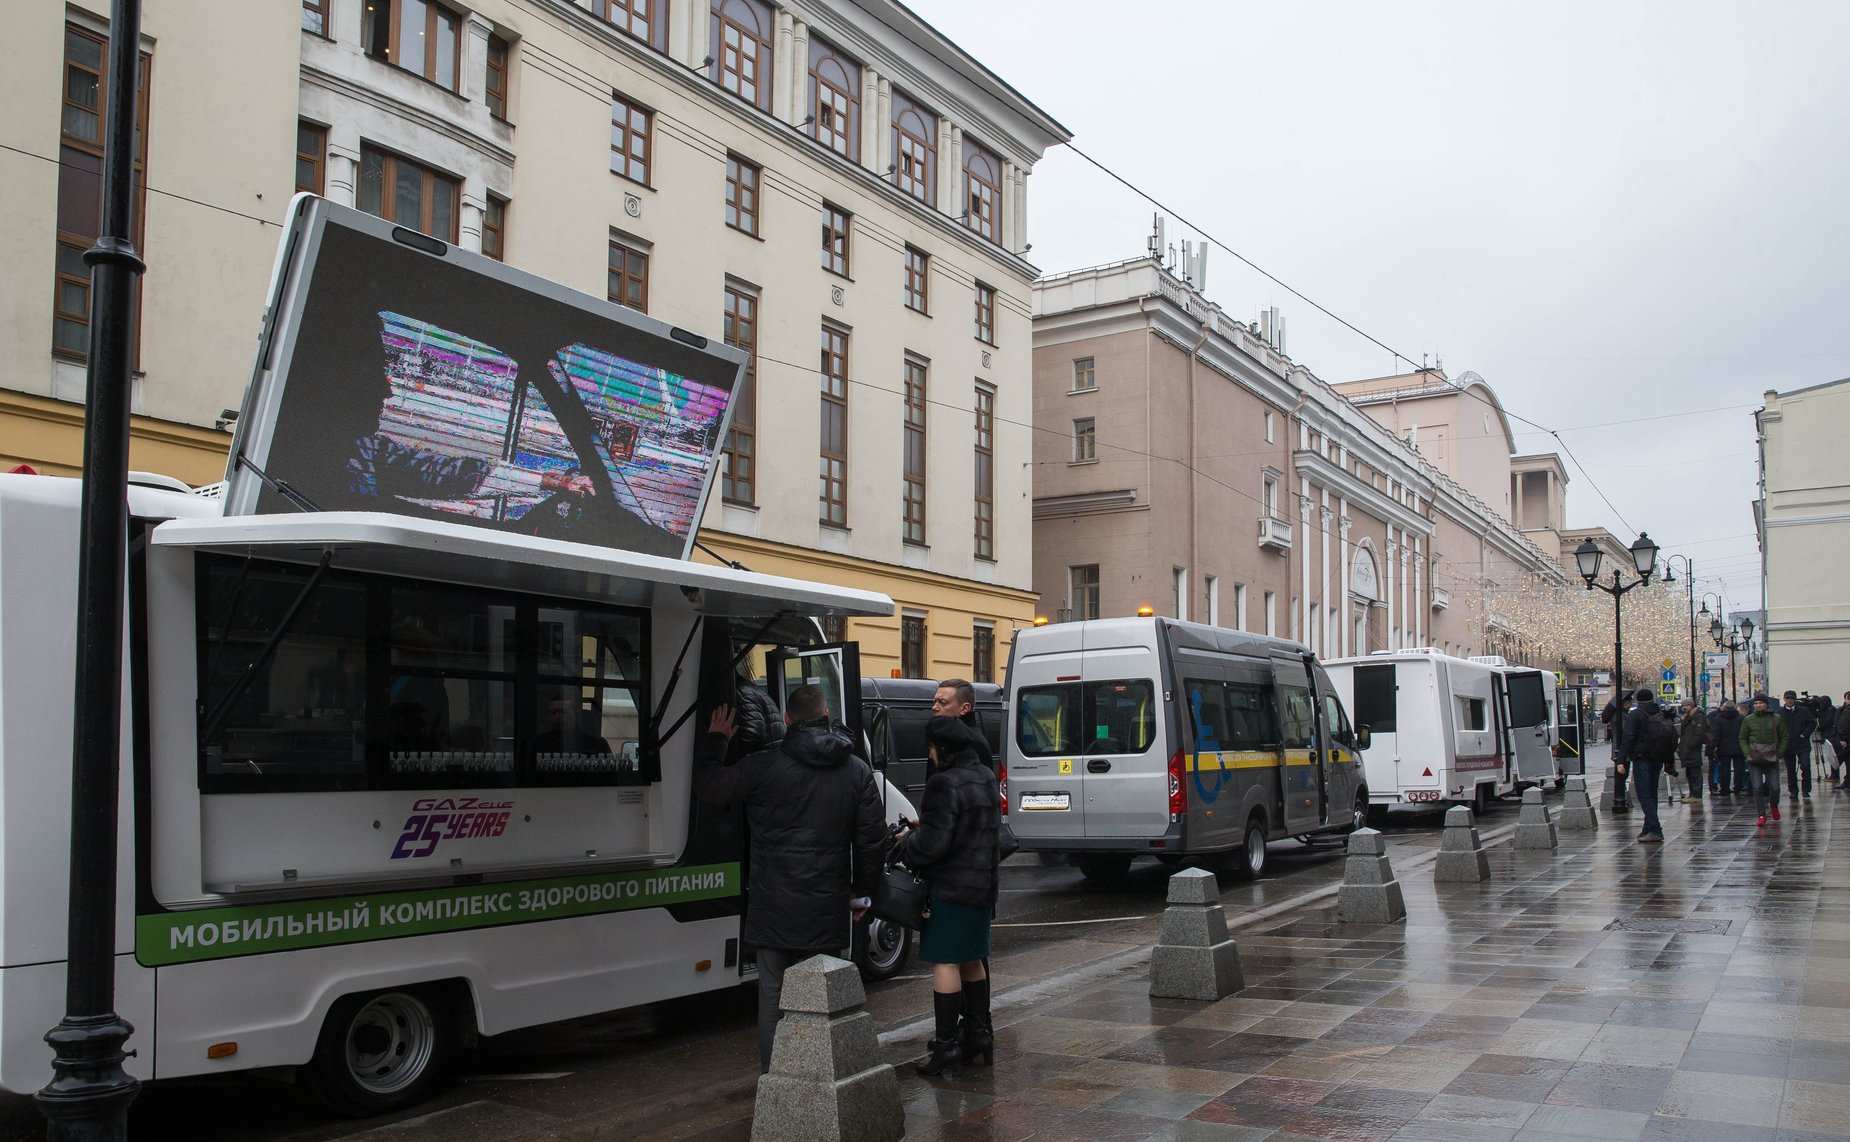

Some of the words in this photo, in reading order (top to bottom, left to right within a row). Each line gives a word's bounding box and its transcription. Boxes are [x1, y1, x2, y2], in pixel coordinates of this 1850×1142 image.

[390, 814, 448, 859] 25
[443, 811, 511, 840] YEARS
[169, 901, 370, 949] МОБИЛЬНЫЙ
[380, 892, 511, 926] КОМПЛЕКС
[518, 880, 639, 911] ЗДОРОВОГО
[645, 871, 725, 896] ПИТАНИЯ
